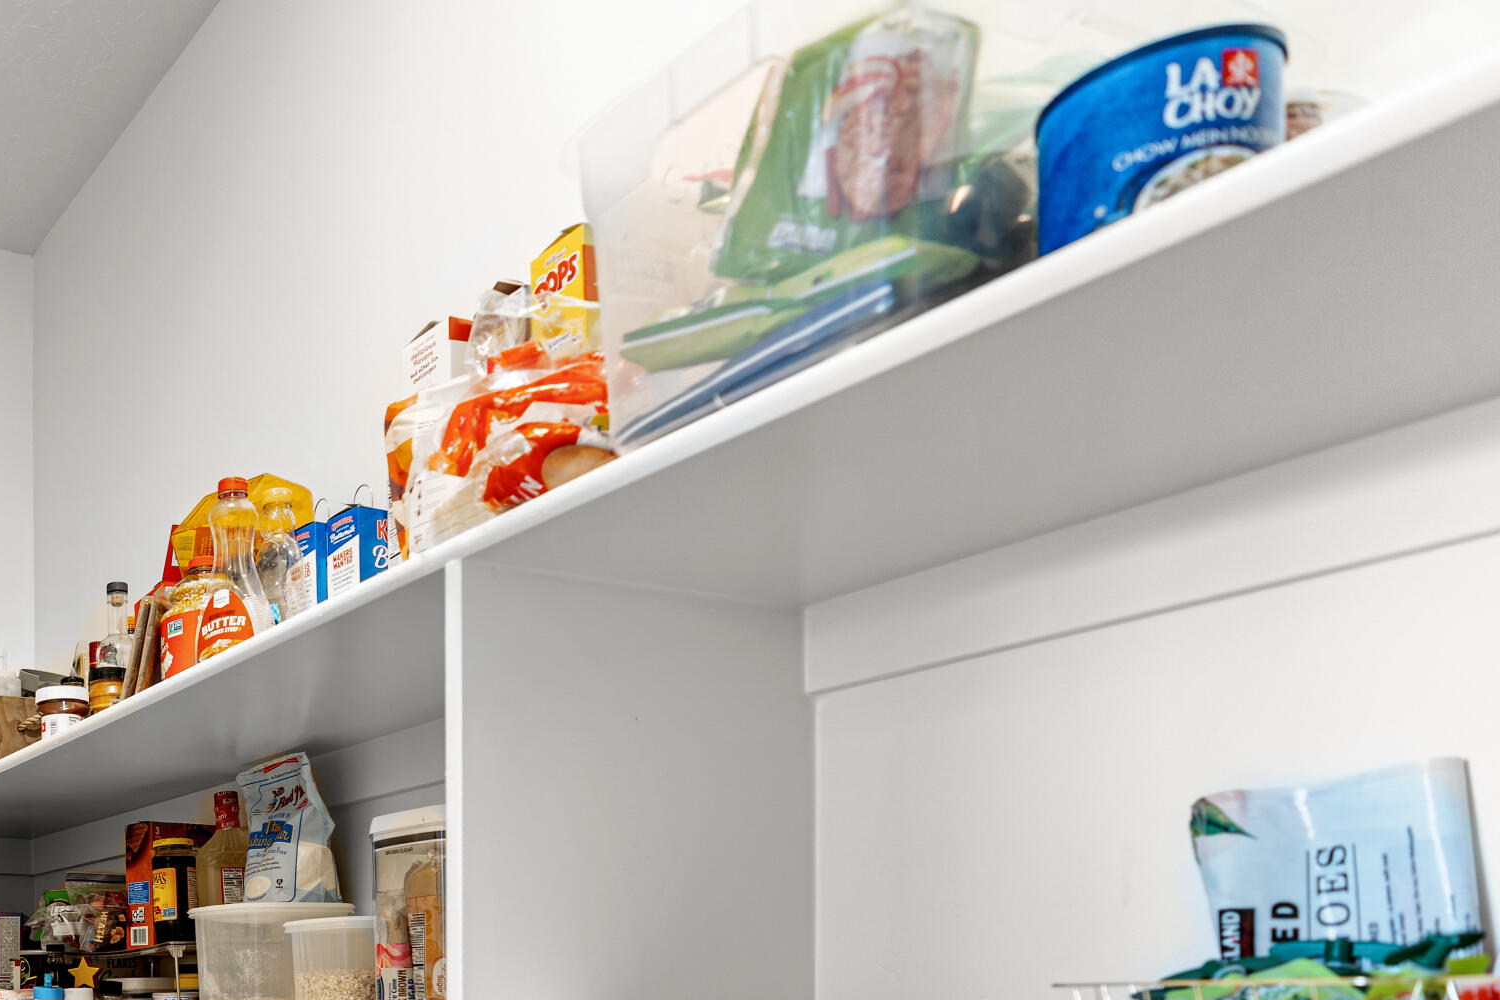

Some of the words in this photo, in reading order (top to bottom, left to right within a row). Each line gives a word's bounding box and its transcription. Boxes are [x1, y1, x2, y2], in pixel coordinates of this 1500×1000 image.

[1165, 57, 1221, 98] LA
[1163, 86, 1261, 129] CHOY
[1111, 139, 1180, 172] CHOW
[201, 616, 246, 637] BUTTER
[95, 911, 109, 943] HEATH
[107, 958, 138, 969] FLAKES
[397, 970, 407, 996] BROWN
